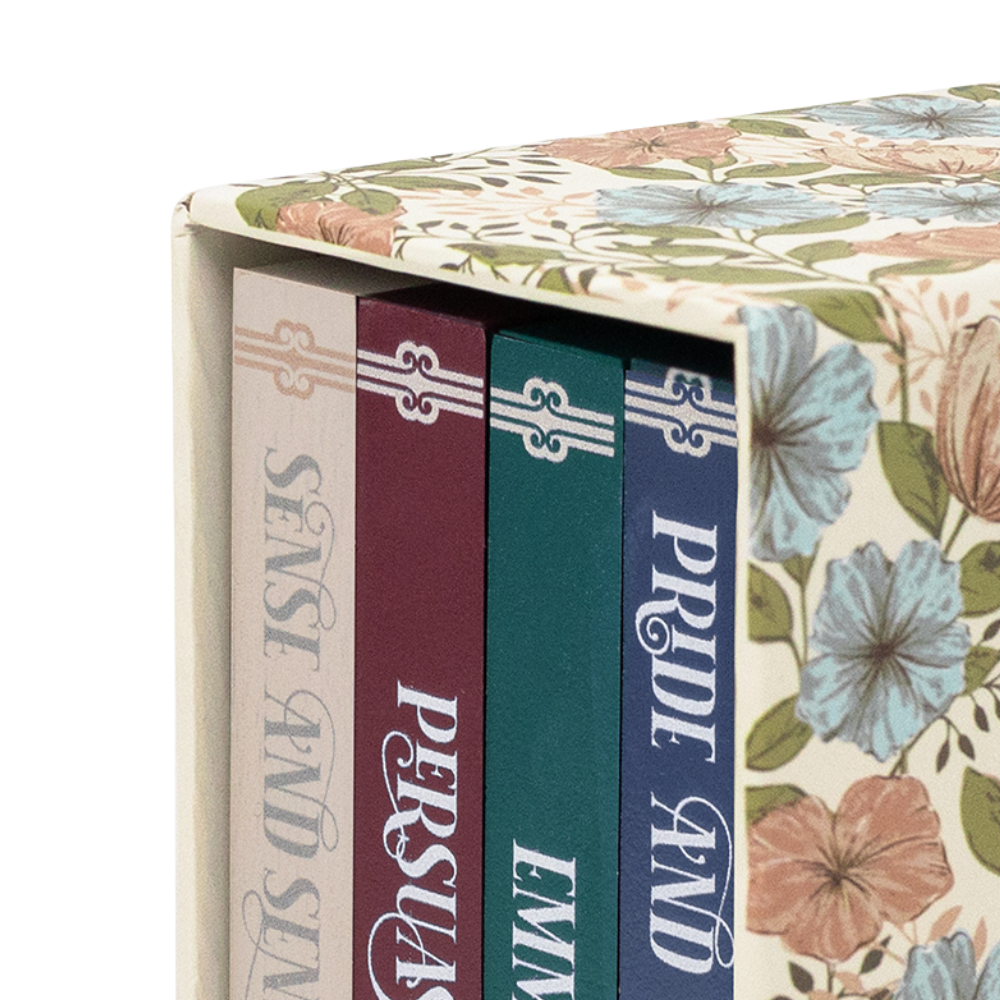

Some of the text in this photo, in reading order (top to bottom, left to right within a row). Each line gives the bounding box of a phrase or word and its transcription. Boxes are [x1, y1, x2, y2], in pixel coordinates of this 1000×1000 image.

[263, 448, 335, 670] SENSE
[635, 510, 718, 764] PRIDE
[261, 682, 339, 858] AND
[650, 791, 735, 975] AND
